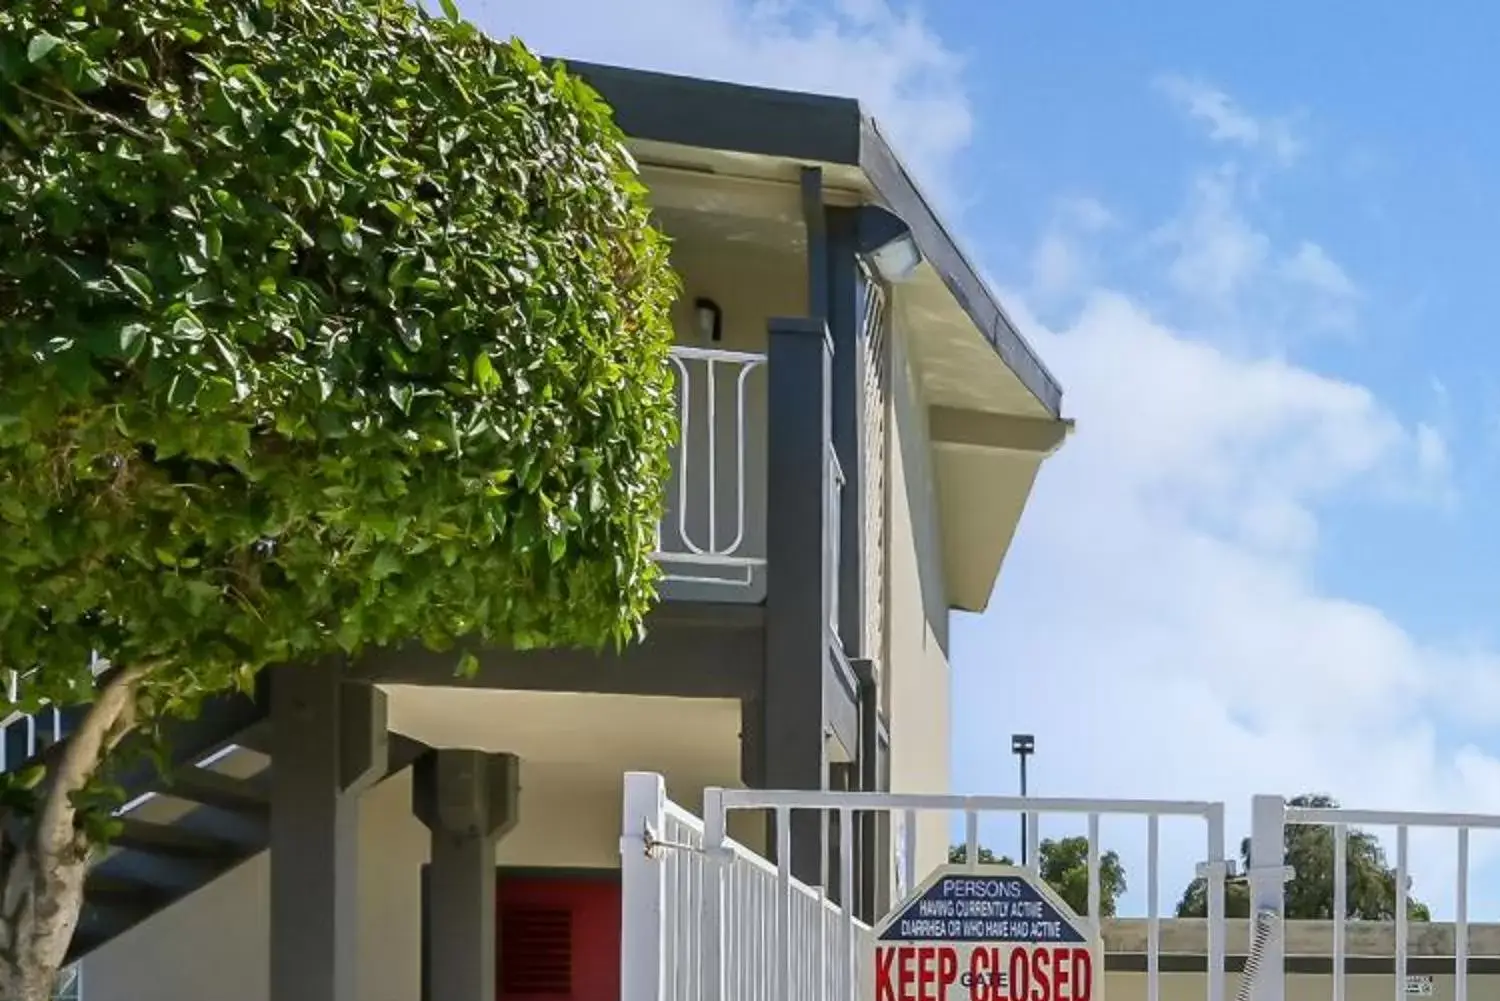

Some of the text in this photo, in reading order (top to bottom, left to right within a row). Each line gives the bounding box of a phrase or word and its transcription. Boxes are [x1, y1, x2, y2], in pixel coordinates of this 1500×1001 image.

[943, 880, 1020, 897] PERSONS
[920, 900, 1043, 918] HAVING CURRENTLY ACTIVE
[902, 920, 1061, 937] DIARRHEA OR WHO HAVE HAD ACTIVE
[961, 971, 1008, 987] GATE
